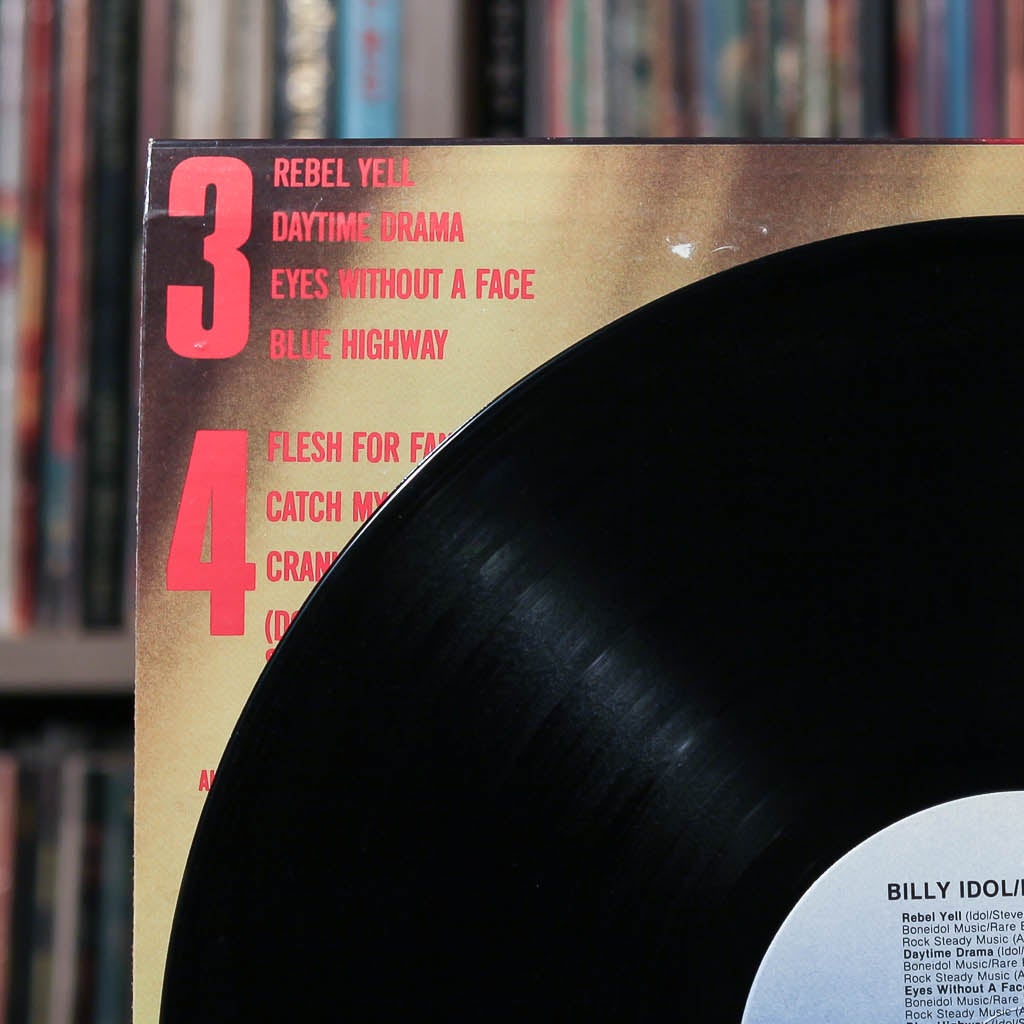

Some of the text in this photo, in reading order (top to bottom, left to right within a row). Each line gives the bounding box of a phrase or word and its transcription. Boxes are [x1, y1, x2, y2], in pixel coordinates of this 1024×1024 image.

[273, 157, 414, 188] REBEL YELL
[272, 212, 465, 244] DAYTIME DRAMA
[165, 156, 254, 359] 3
[270, 268, 536, 300] EYES WITHOUT A FACE
[269, 329, 449, 360] BLUE HIGHWAY
[267, 431, 452, 463] FLESH FOR FA
[266, 491, 342, 522] CATCH
[166, 429, 256, 636] 4
[266, 551, 338, 582] CRAN
[887, 881, 951, 901] BILLY
[902, 911, 935, 923] Rebel
[940, 910, 962, 921] Yell
[902, 924, 950, 935] Boneidol
[954, 921, 1016, 933] Music/Rare
[902, 937, 931, 948] Rock
[934, 935, 972, 947] Steady
[976, 934, 1009, 945] Music
[903, 948, 952, 961] Daytime
[956, 947, 994, 958] Drama
[903, 960, 951, 971] Boneidol
[955, 958, 1018, 969] Music/Rare
[903, 973, 931, 984] Rock
[935, 972, 974, 984] Steady
[977, 971, 1010, 981] Music
[905, 985, 933, 998] Eyes
[937, 984, 984, 995] Without
[988, 983, 997, 993] A
[905, 997, 953, 1008] Boneidol
[957, 995, 1019, 1006] Music/Rare
[905, 1010, 933, 1020] Rock
[937, 1008, 975, 1020] Steady
[979, 1007, 1011, 1017] Music
